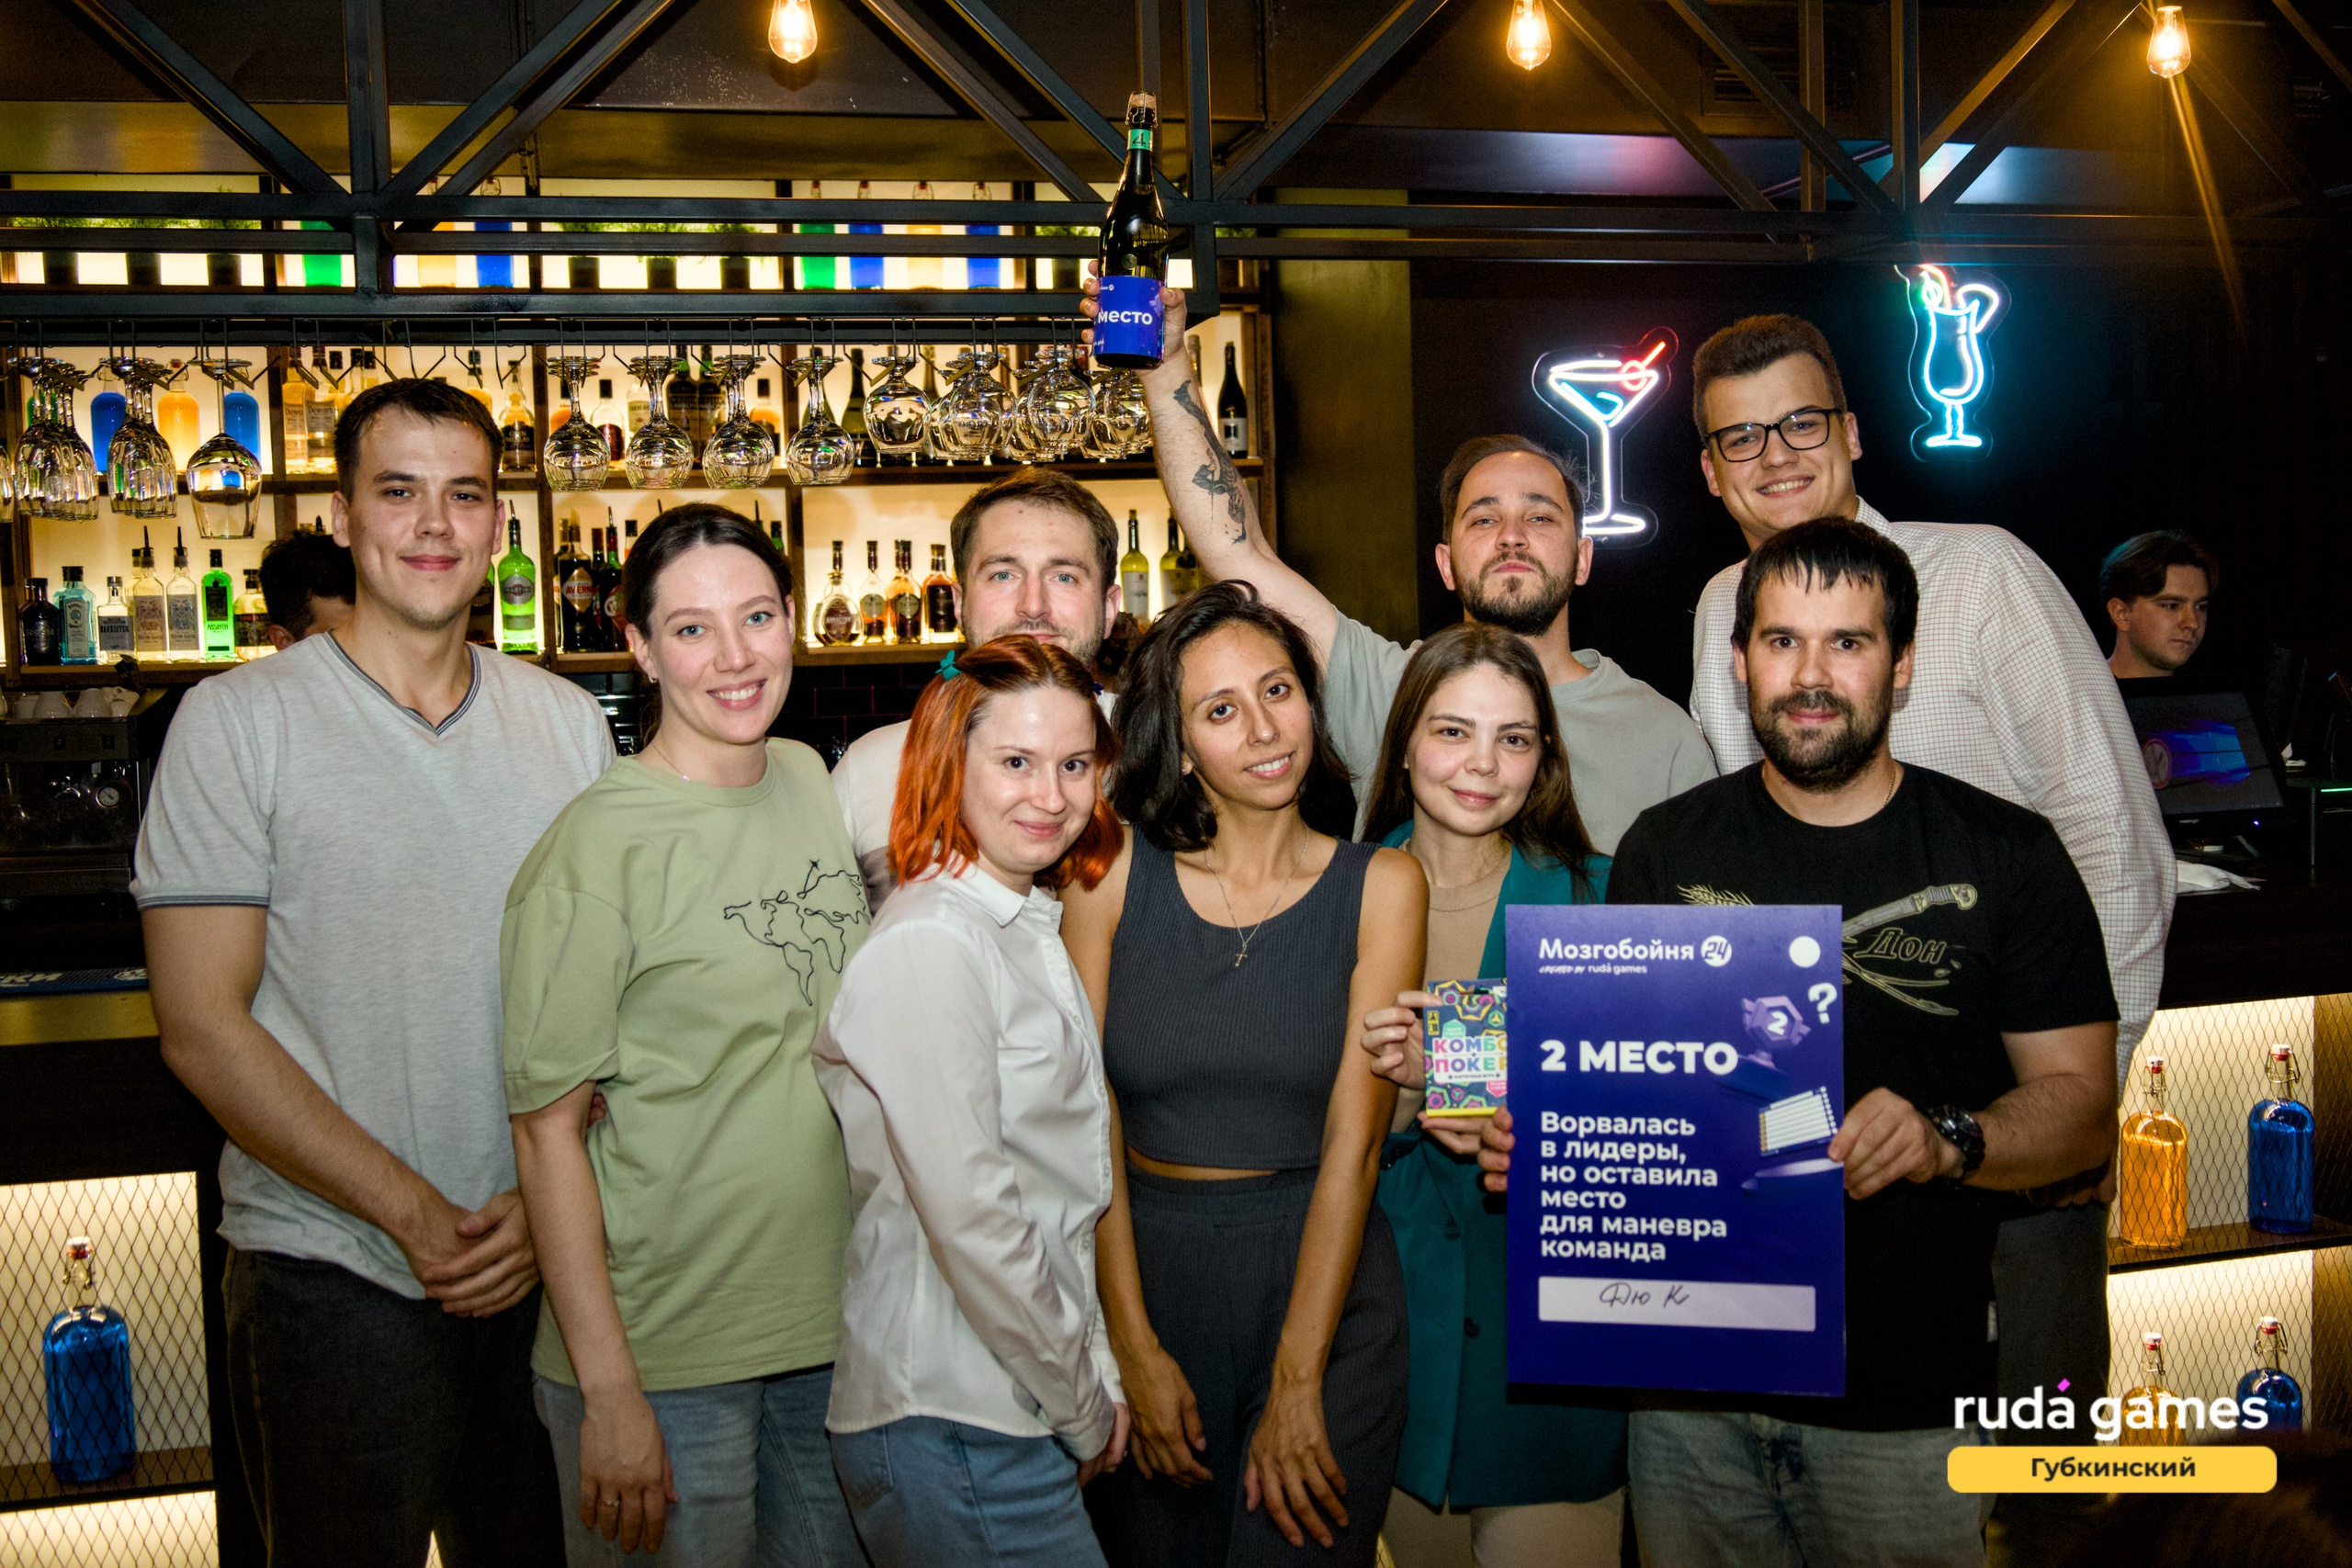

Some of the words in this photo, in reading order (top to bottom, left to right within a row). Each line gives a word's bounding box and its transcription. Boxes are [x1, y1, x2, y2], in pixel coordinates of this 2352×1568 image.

[1097, 310, 1153, 325] место
[1539, 937, 1694, 961] Мозгобойня
[1703, 939, 1730, 961] 24
[1613, 965, 1648, 976] games
[1540, 1039, 1566, 1072] 2
[1578, 1040, 1739, 1076] МЕСТО
[1541, 1111, 1697, 1139] Ворвалась
[1541, 1140, 1557, 1158] в
[1564, 1141, 1687, 1165] лидеры,
[1541, 1165, 1577, 1183] но
[1583, 1166, 1718, 1187] оставила
[1541, 1190, 1627, 1209] место
[1540, 1214, 1594, 1235] для
[1602, 1216, 1727, 1242] маневра
[1541, 1239, 1667, 1263] команда
